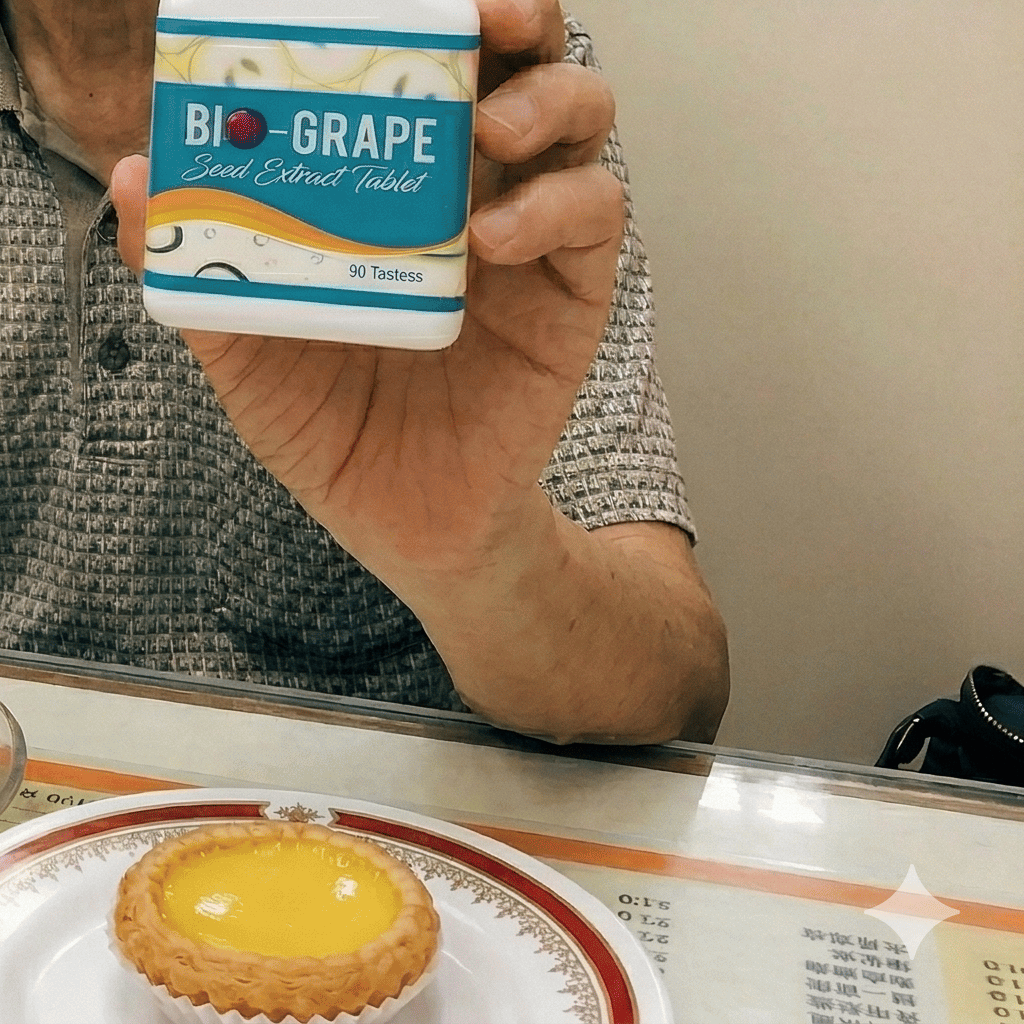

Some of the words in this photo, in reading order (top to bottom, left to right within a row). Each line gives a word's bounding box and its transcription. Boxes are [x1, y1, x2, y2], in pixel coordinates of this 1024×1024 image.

[181, 153, 254, 182] Seed
[254, 158, 351, 187] Extract
[351, 164, 433, 194] Tablet
[349, 264, 366, 278] 90
[370, 265, 423, 282] Tastess
